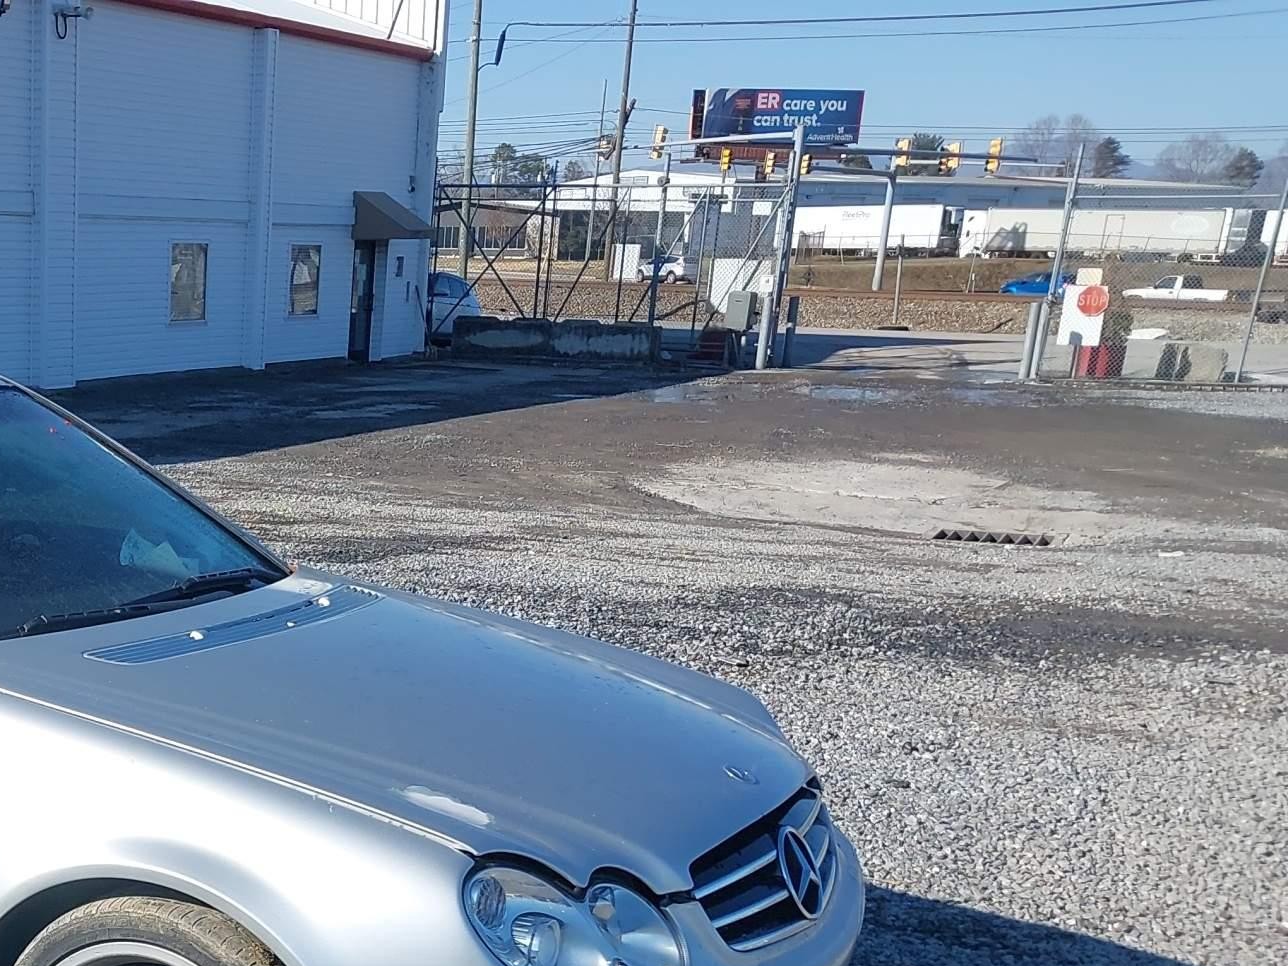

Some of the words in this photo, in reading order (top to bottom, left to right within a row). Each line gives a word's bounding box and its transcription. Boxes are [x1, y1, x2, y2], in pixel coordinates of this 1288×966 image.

[757, 92, 780, 109] ER
[783, 99, 815, 111] care
[819, 99, 847, 114] you
[753, 115, 780, 127] can
[783, 113, 821, 127] trust.
[807, 133, 854, 142] AdventHealth
[1078, 294, 1107, 306] STOP
